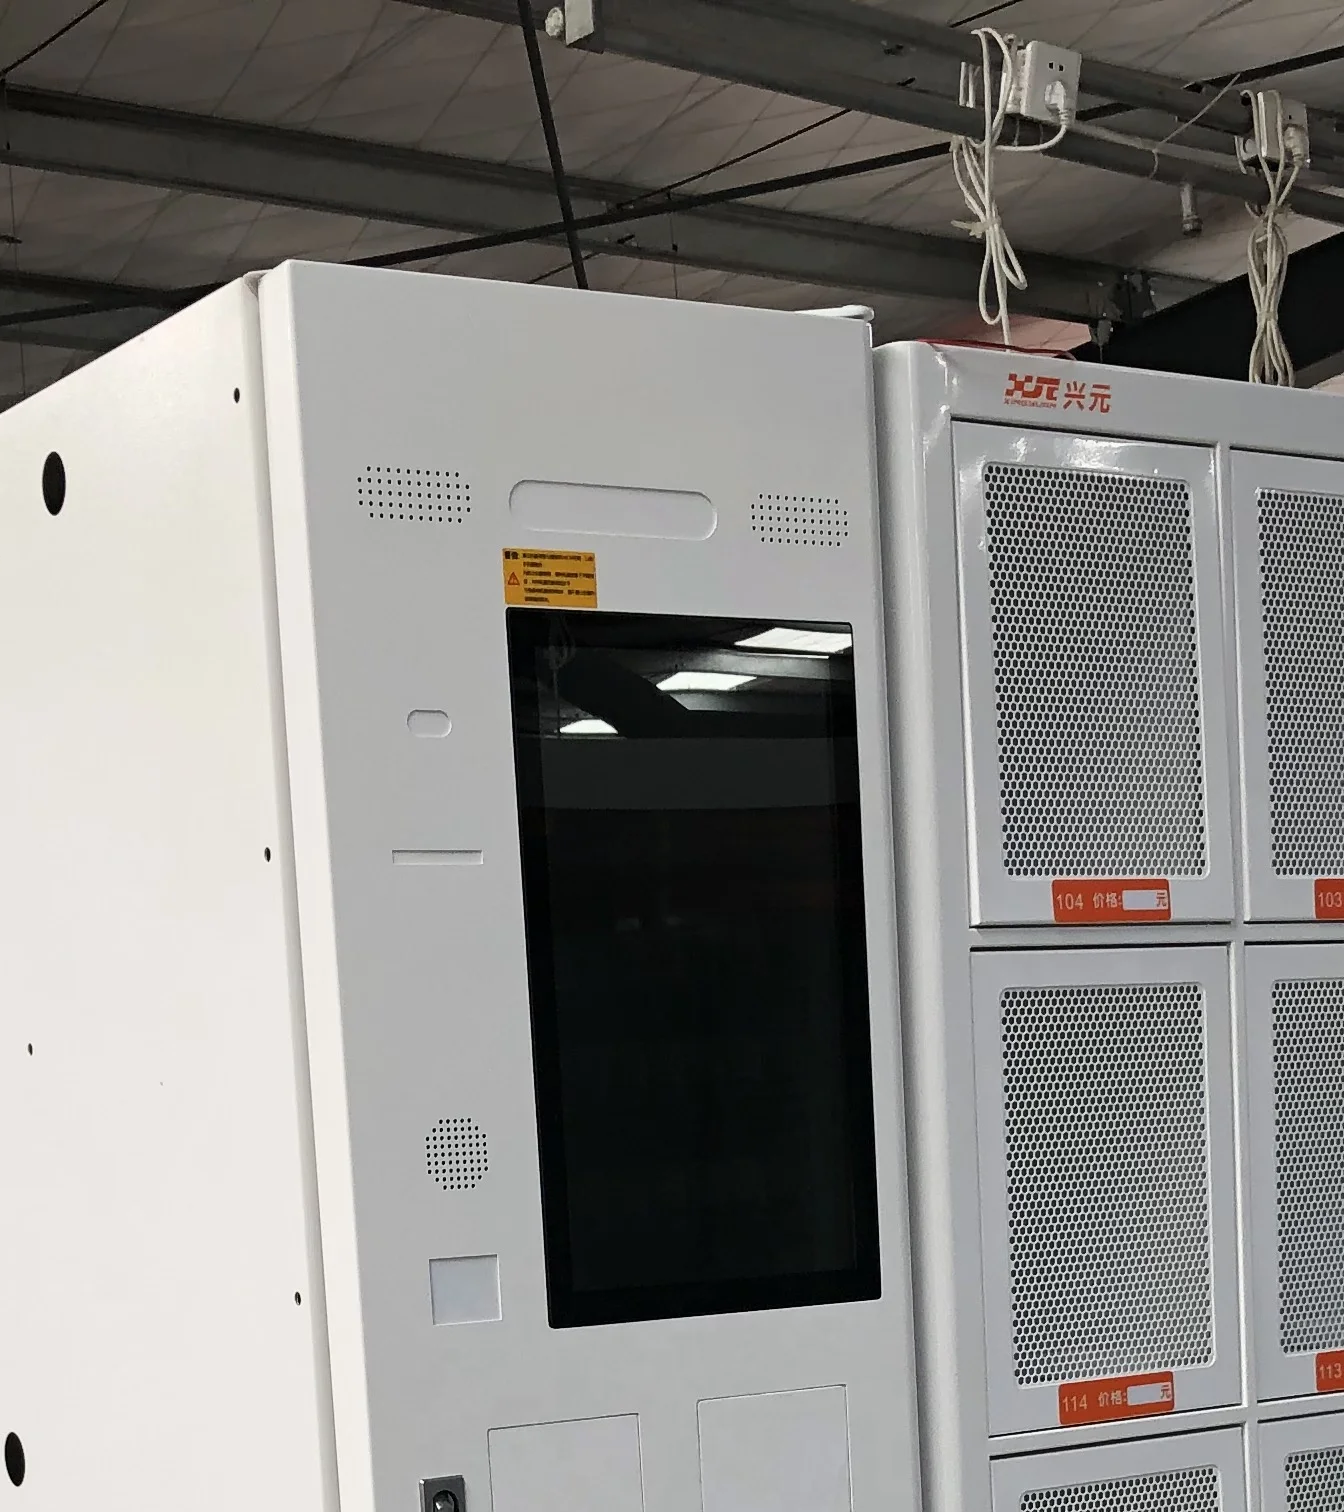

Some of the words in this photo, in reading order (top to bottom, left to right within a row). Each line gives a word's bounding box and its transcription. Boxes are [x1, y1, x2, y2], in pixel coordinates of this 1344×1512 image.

[1063, 381, 1111, 413] 兴元
[1057, 892, 1084, 910] 104
[1318, 892, 1342, 907] 103
[1320, 1363, 1342, 1379] 113
[1062, 1394, 1087, 1412] 114
